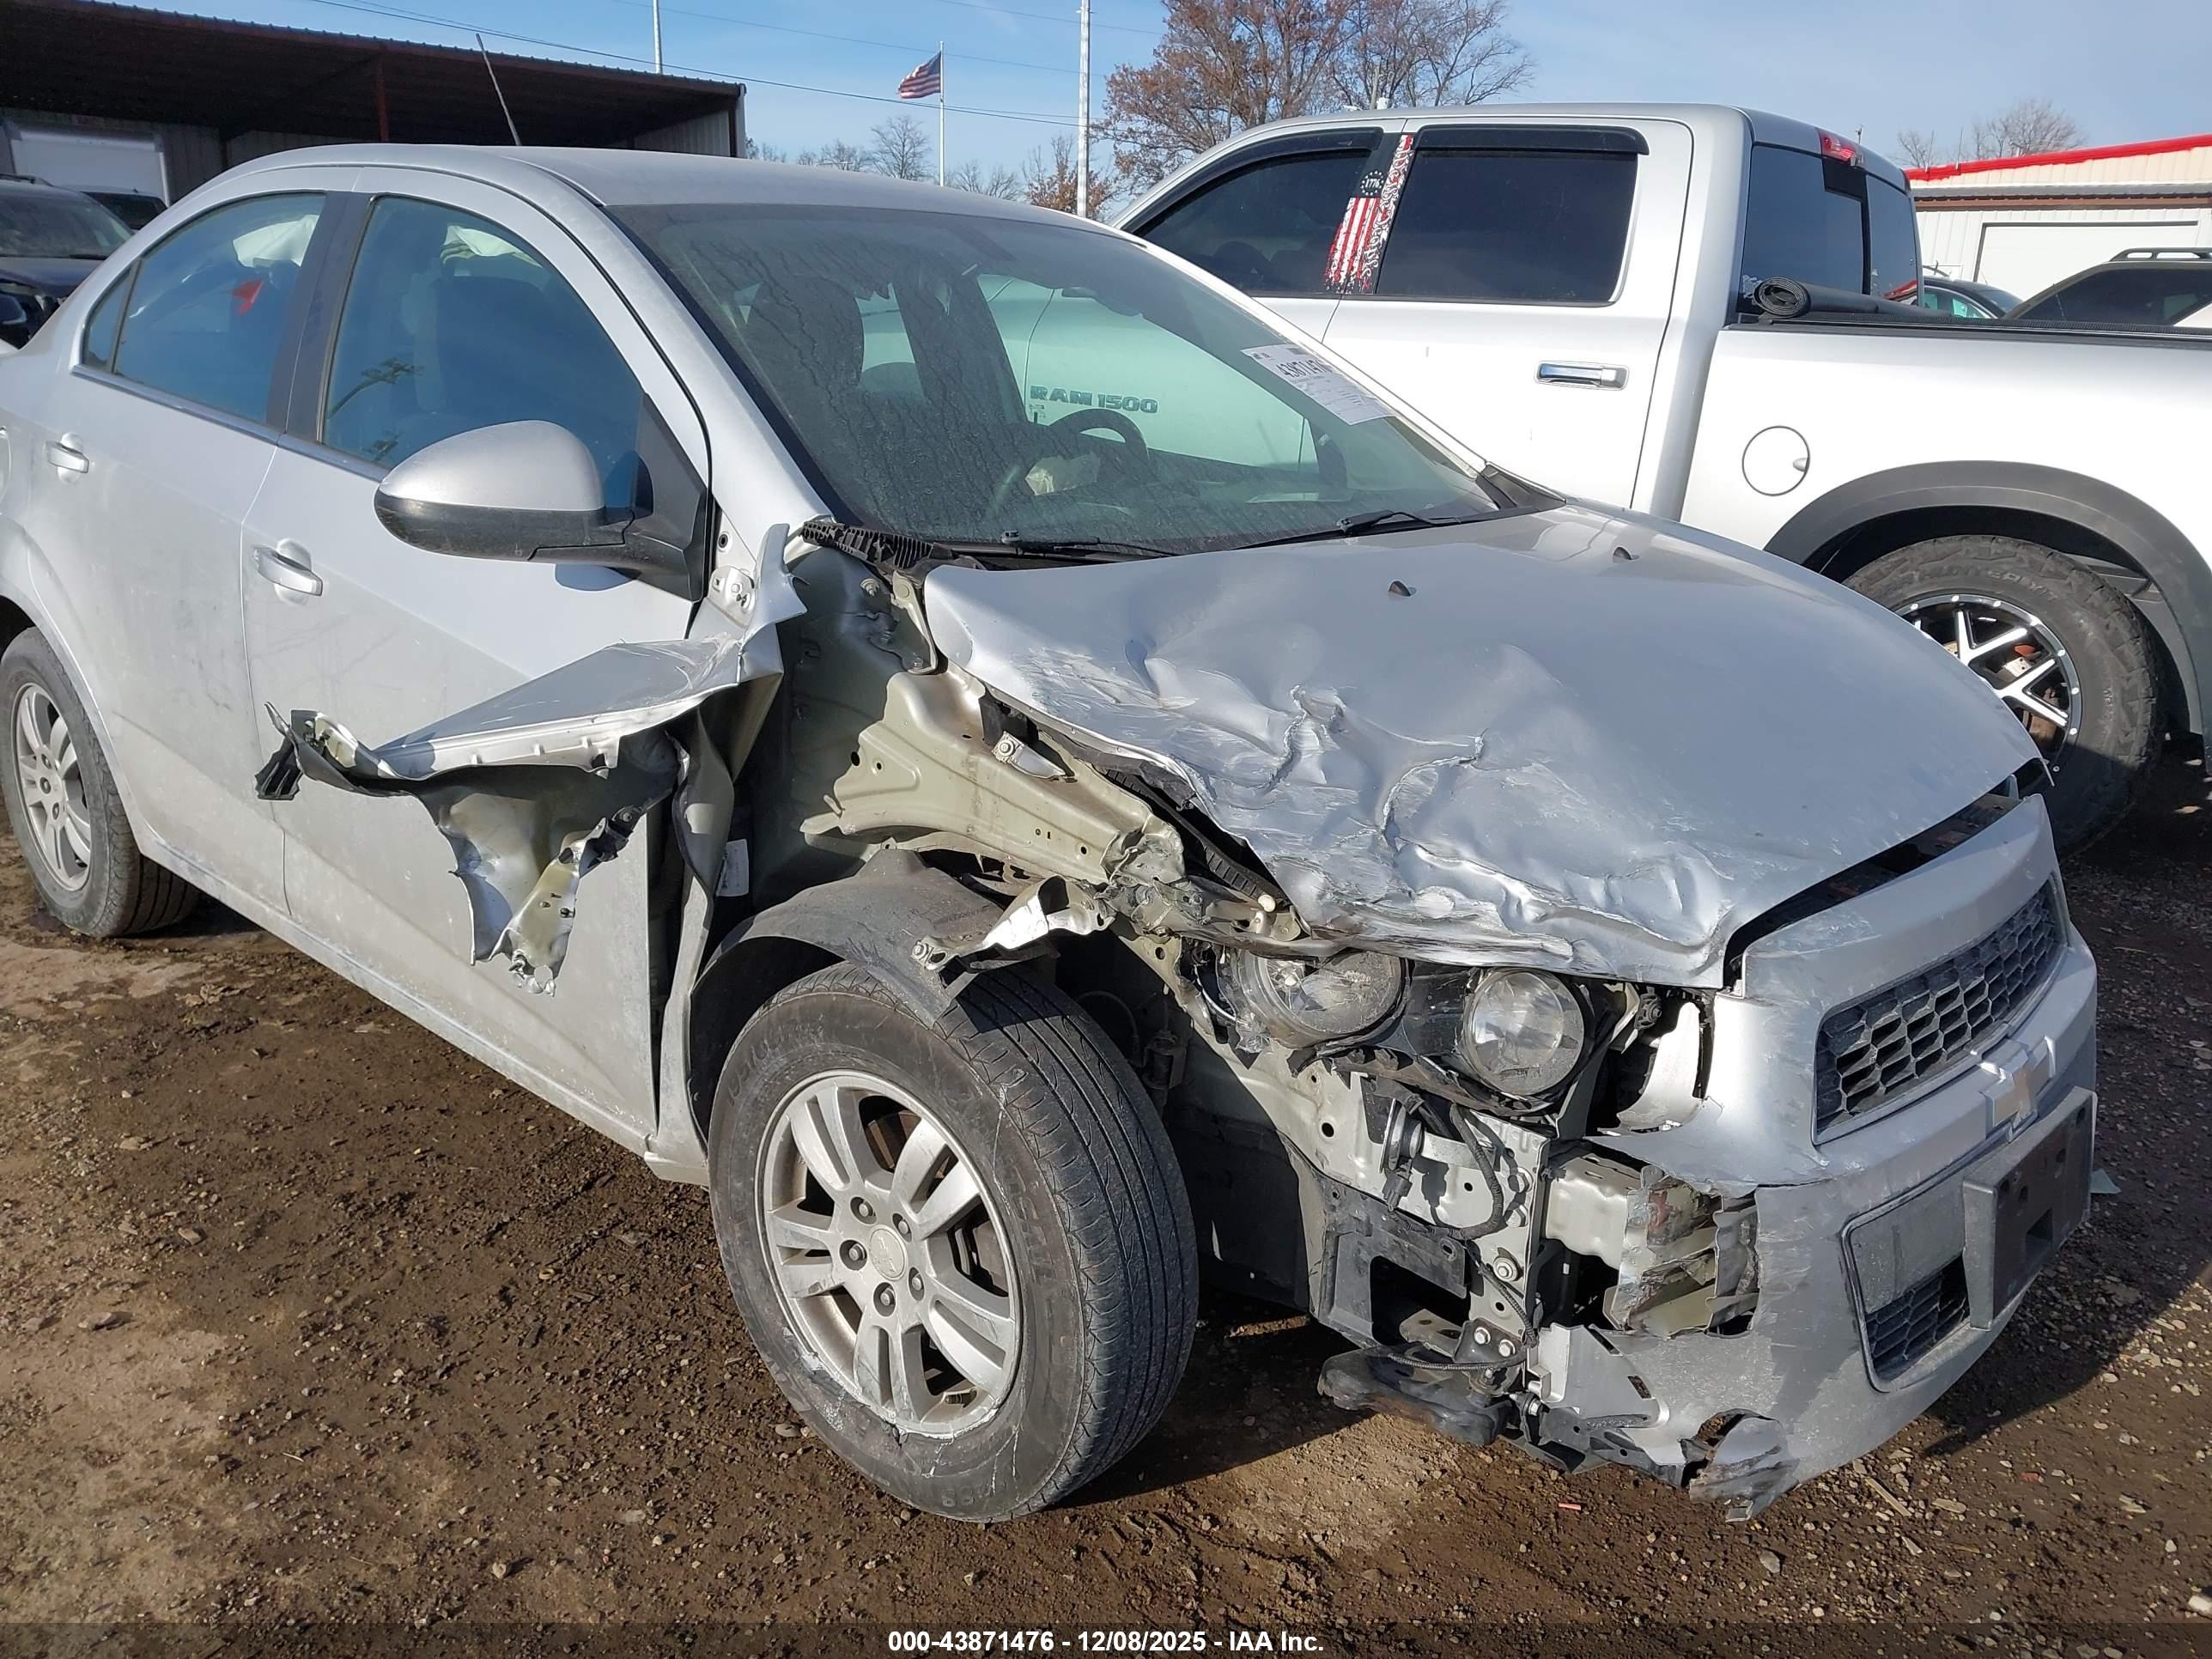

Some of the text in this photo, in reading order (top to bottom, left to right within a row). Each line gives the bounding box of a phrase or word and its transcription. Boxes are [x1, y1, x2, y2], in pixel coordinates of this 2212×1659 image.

[1364, 178, 1381, 189] 1776
[1030, 386, 1158, 414] RAM 1500
